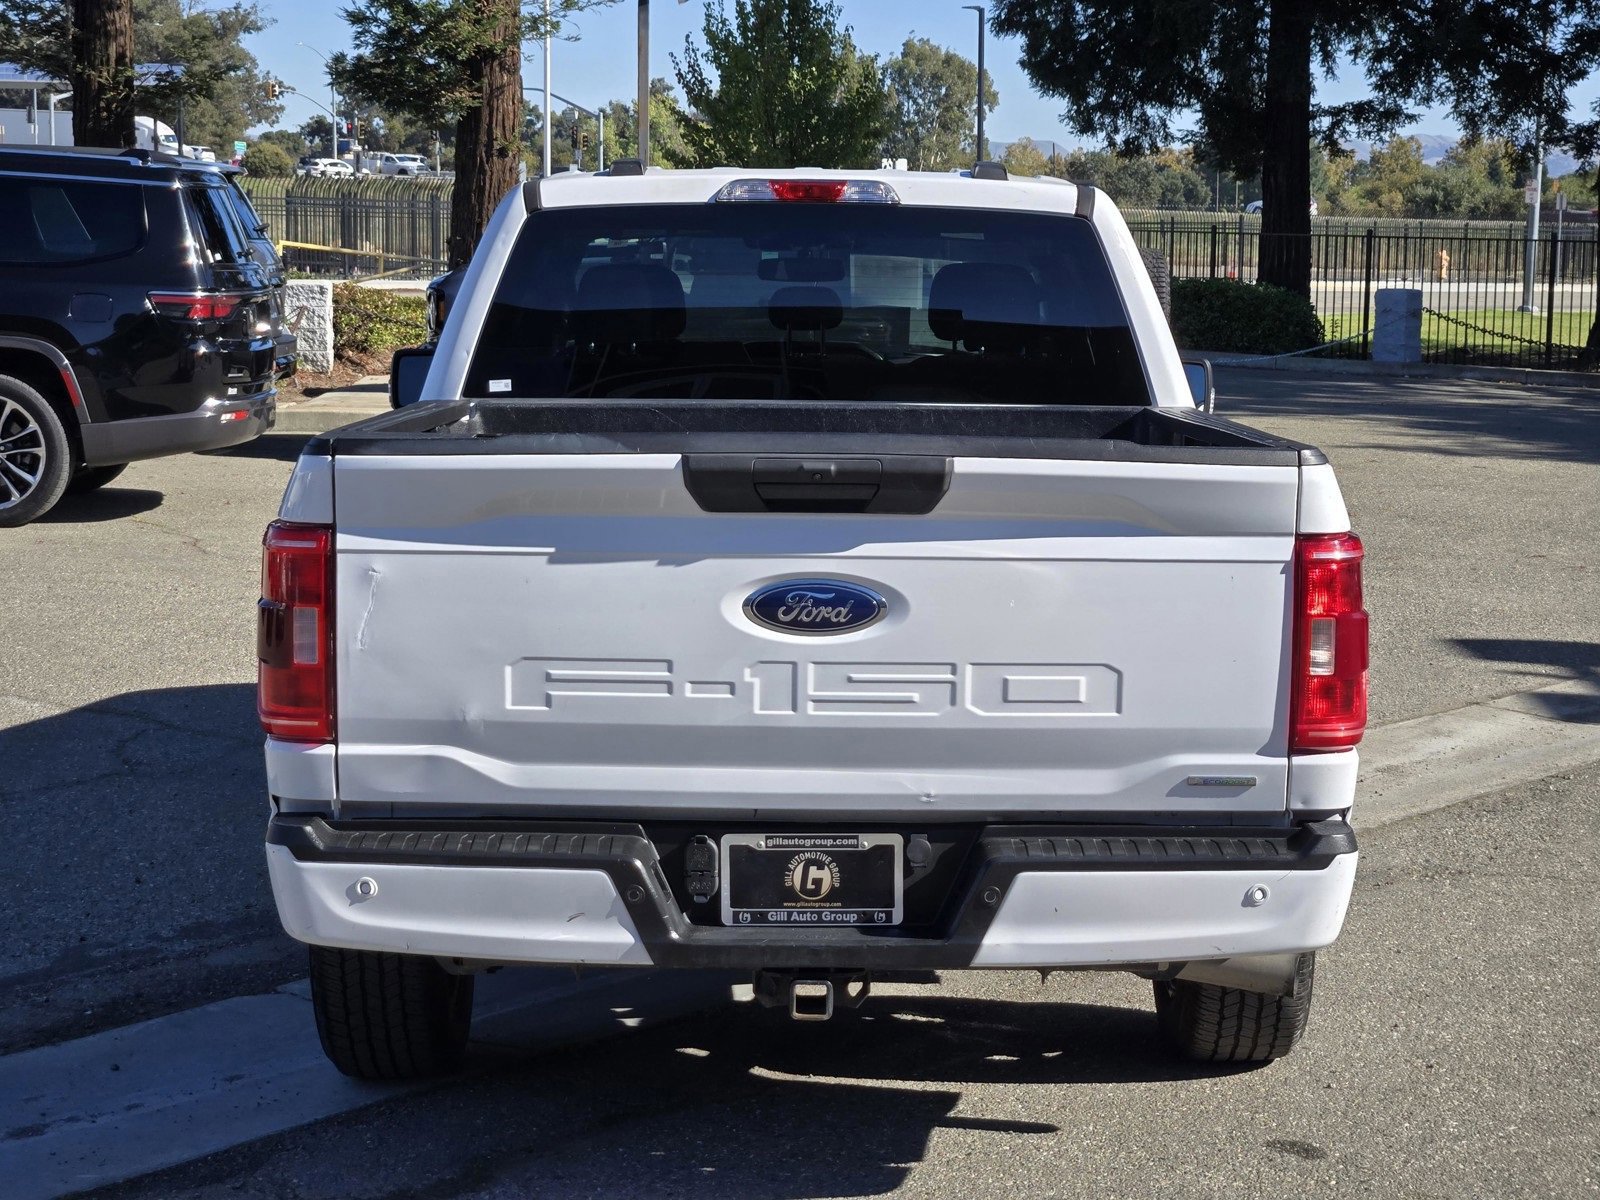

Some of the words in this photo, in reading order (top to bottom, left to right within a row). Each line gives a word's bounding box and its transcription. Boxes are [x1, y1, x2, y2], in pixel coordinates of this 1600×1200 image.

[777, 590, 852, 623] Ford
[504, 657, 1123, 717] F-150
[766, 837, 858, 847] gillautogroup.com
[787, 851, 833, 871] AUTOMOTIVE
[784, 870, 794, 887] GILL
[829, 862, 841, 888] GROUP
[767, 911, 788, 921] Gill
[790, 911, 818, 921] Auto
[821, 911, 858, 923] Group
